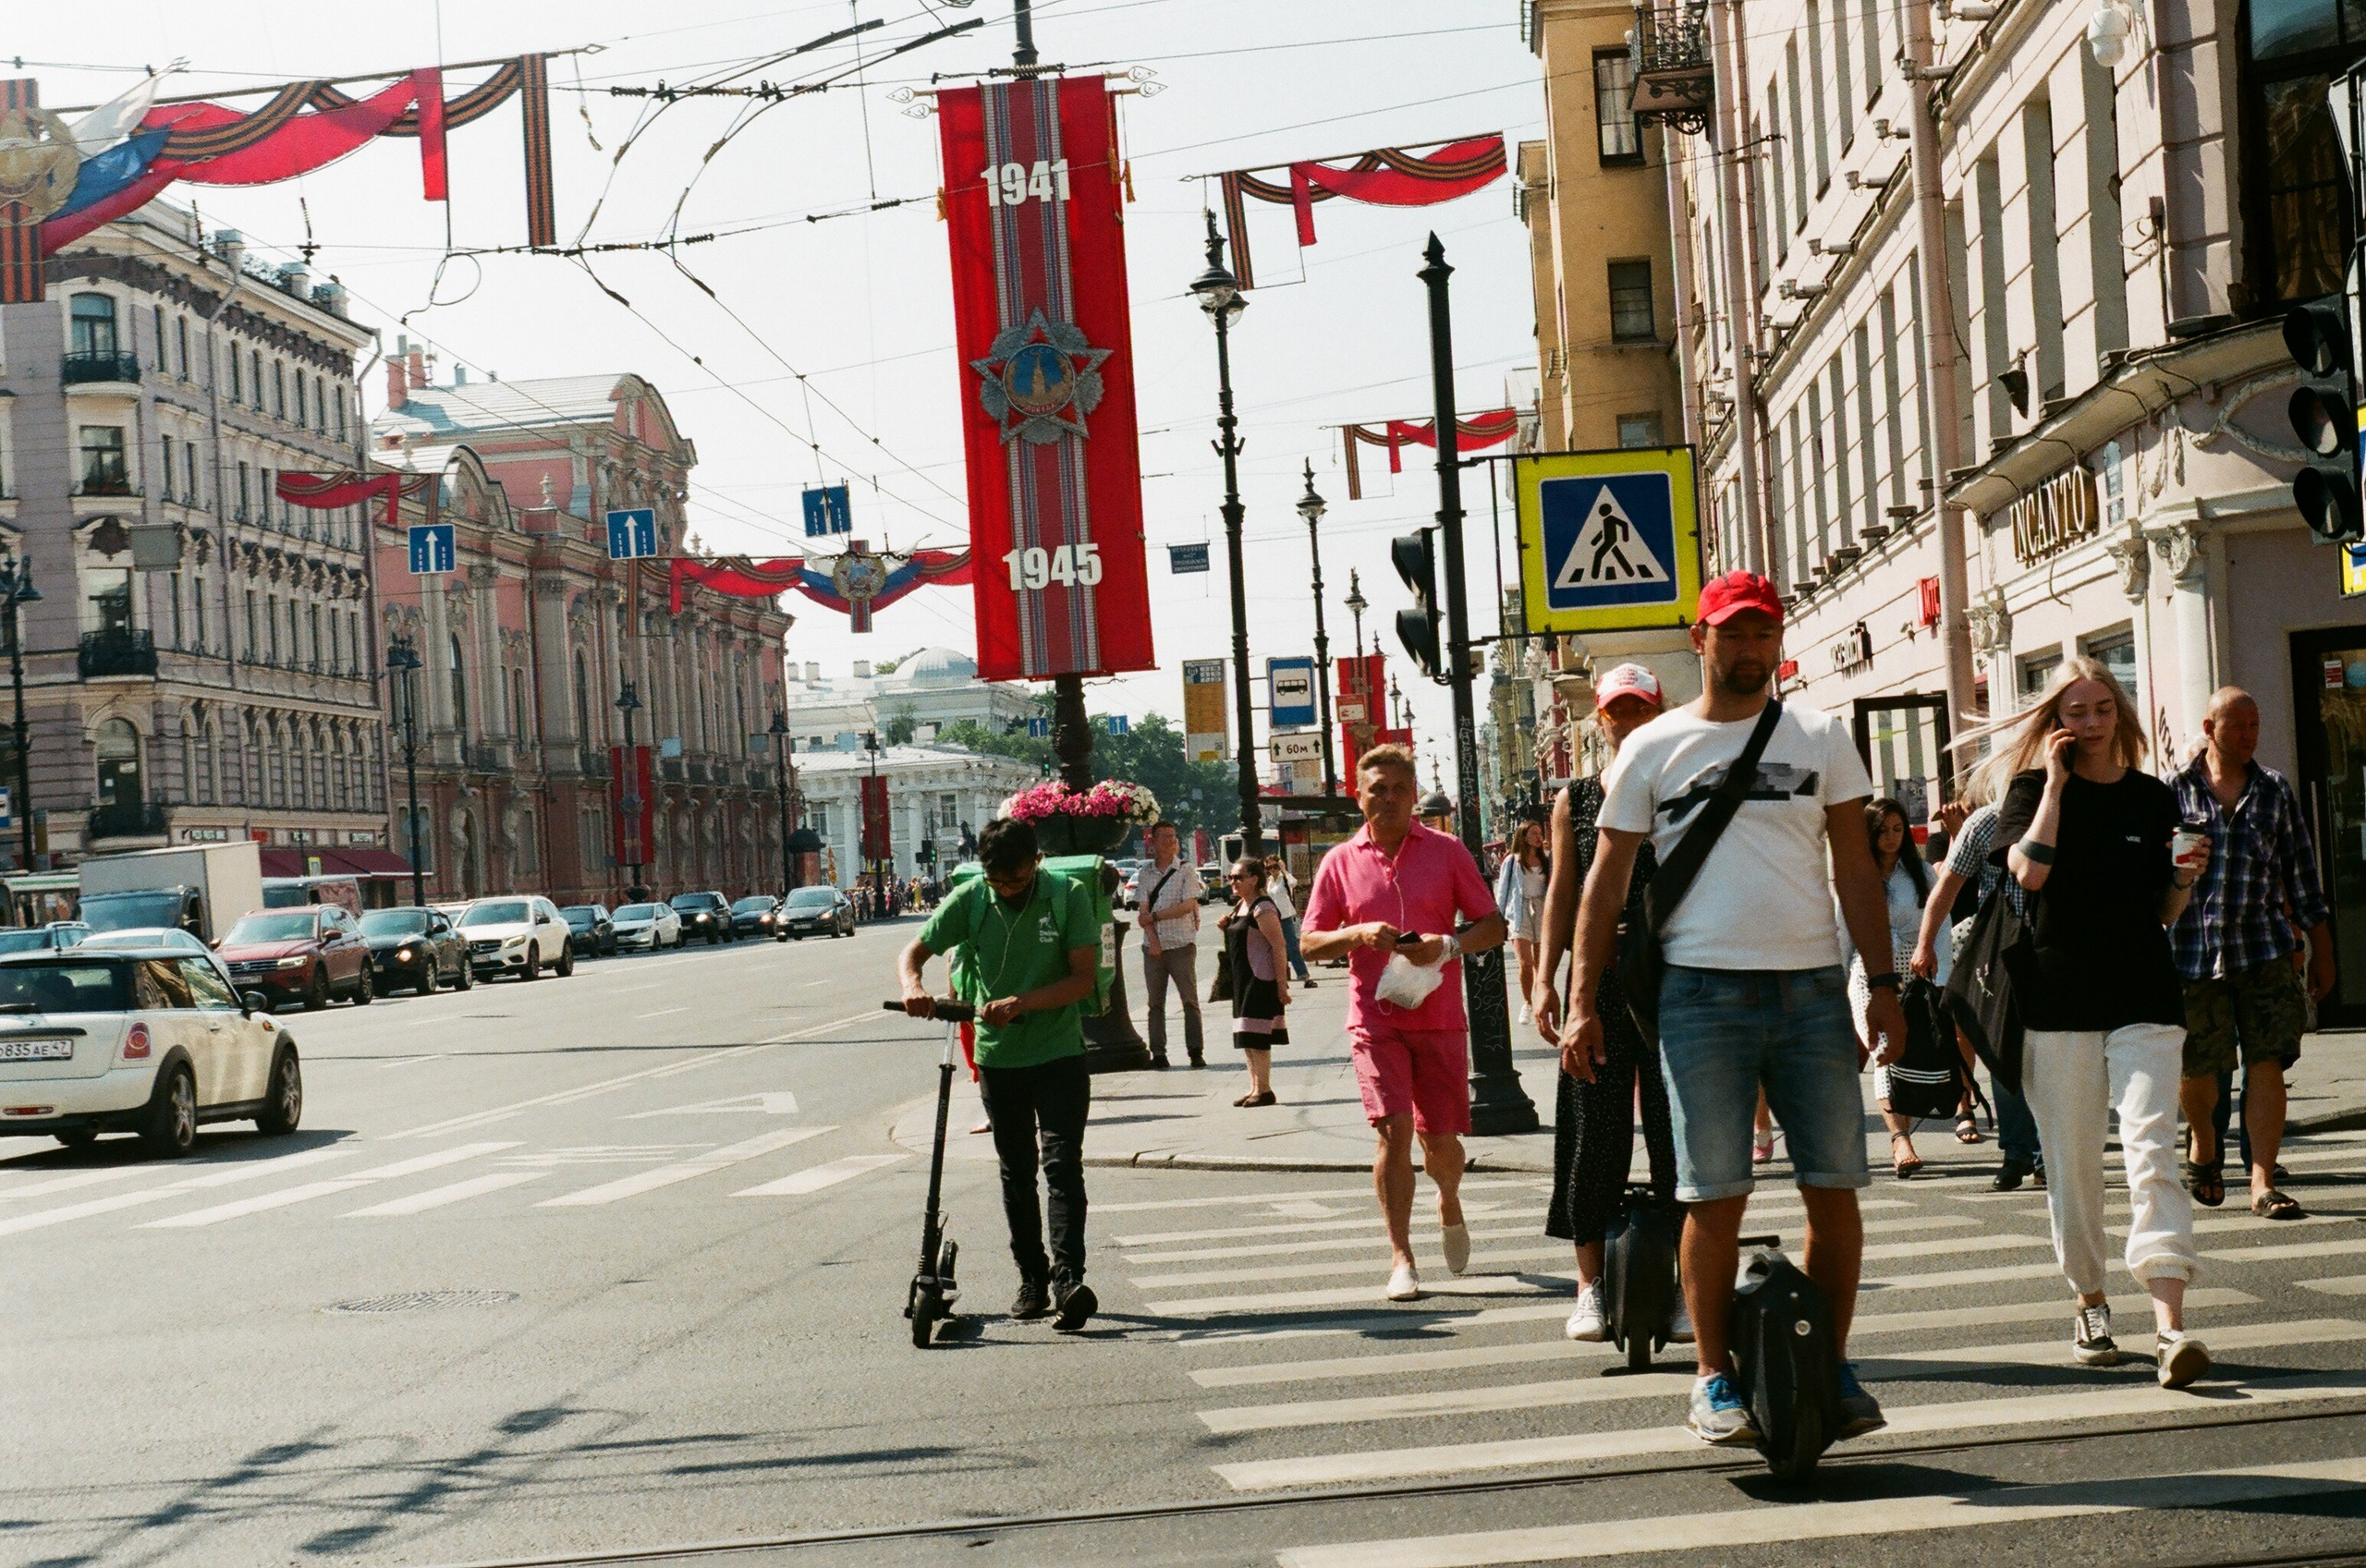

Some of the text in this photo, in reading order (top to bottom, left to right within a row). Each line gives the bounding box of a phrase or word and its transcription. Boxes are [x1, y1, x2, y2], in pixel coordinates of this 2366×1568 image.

[981, 158, 1070, 207] 1941
[1022, 347, 1052, 358] СССР
[1026, 402, 1057, 412] ПОБЕДА
[2009, 465, 2086, 563] INCANTO
[1002, 542, 1103, 591] 1945
[1286, 743, 1309, 754] 60м
[53, 1041, 67, 1051] 47
